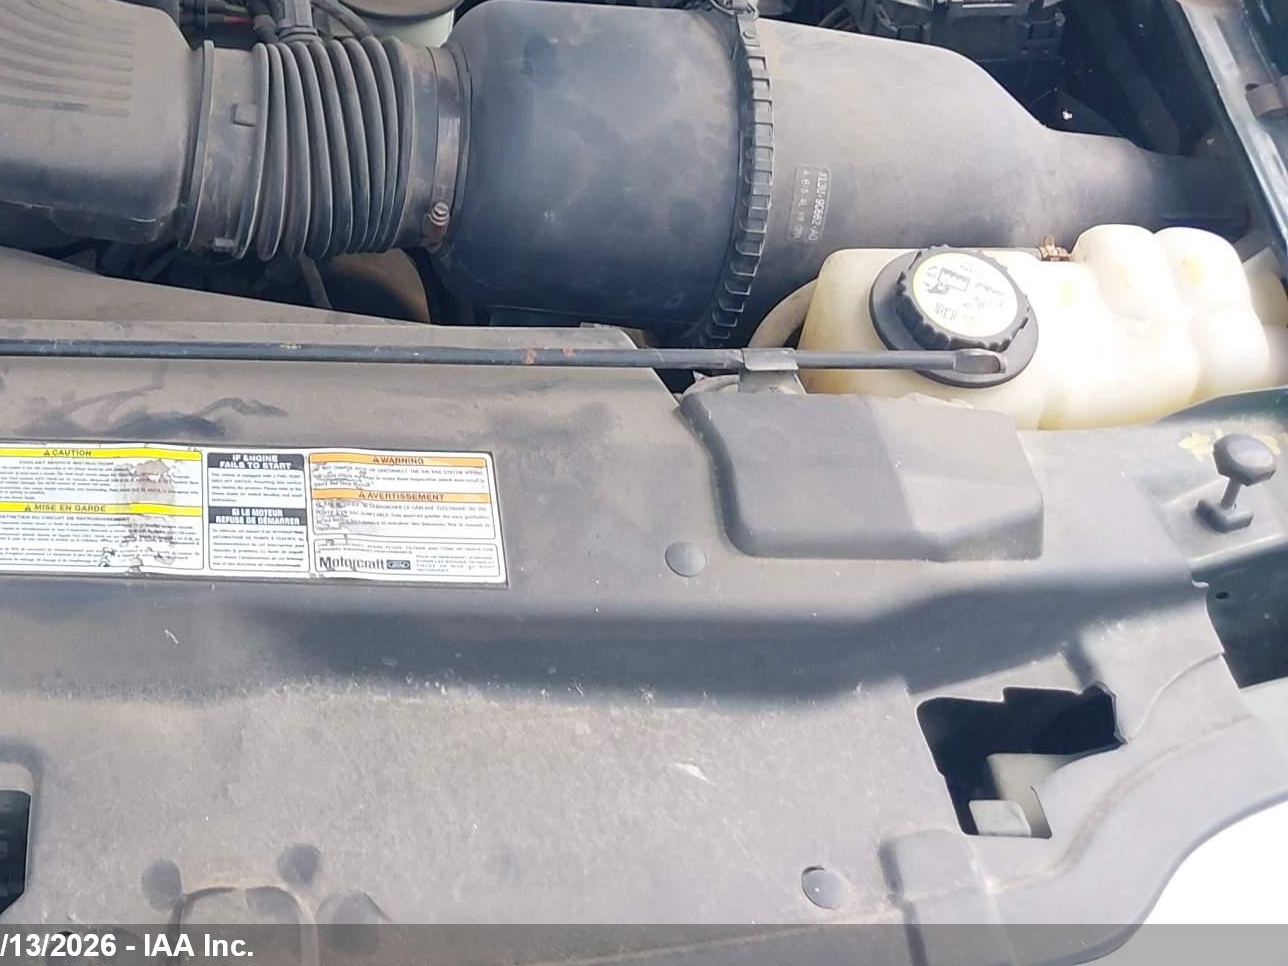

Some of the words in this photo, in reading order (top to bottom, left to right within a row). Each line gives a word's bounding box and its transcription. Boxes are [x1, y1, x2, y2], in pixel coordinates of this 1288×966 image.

[52, 449, 92, 457] CAUTION
[380, 456, 424, 465] WARNING
[219, 461, 245, 469] FAILS
[262, 462, 292, 470] START
[368, 492, 445, 501] AVERTISSEMENT
[319, 555, 385, 572] Motorcraft
